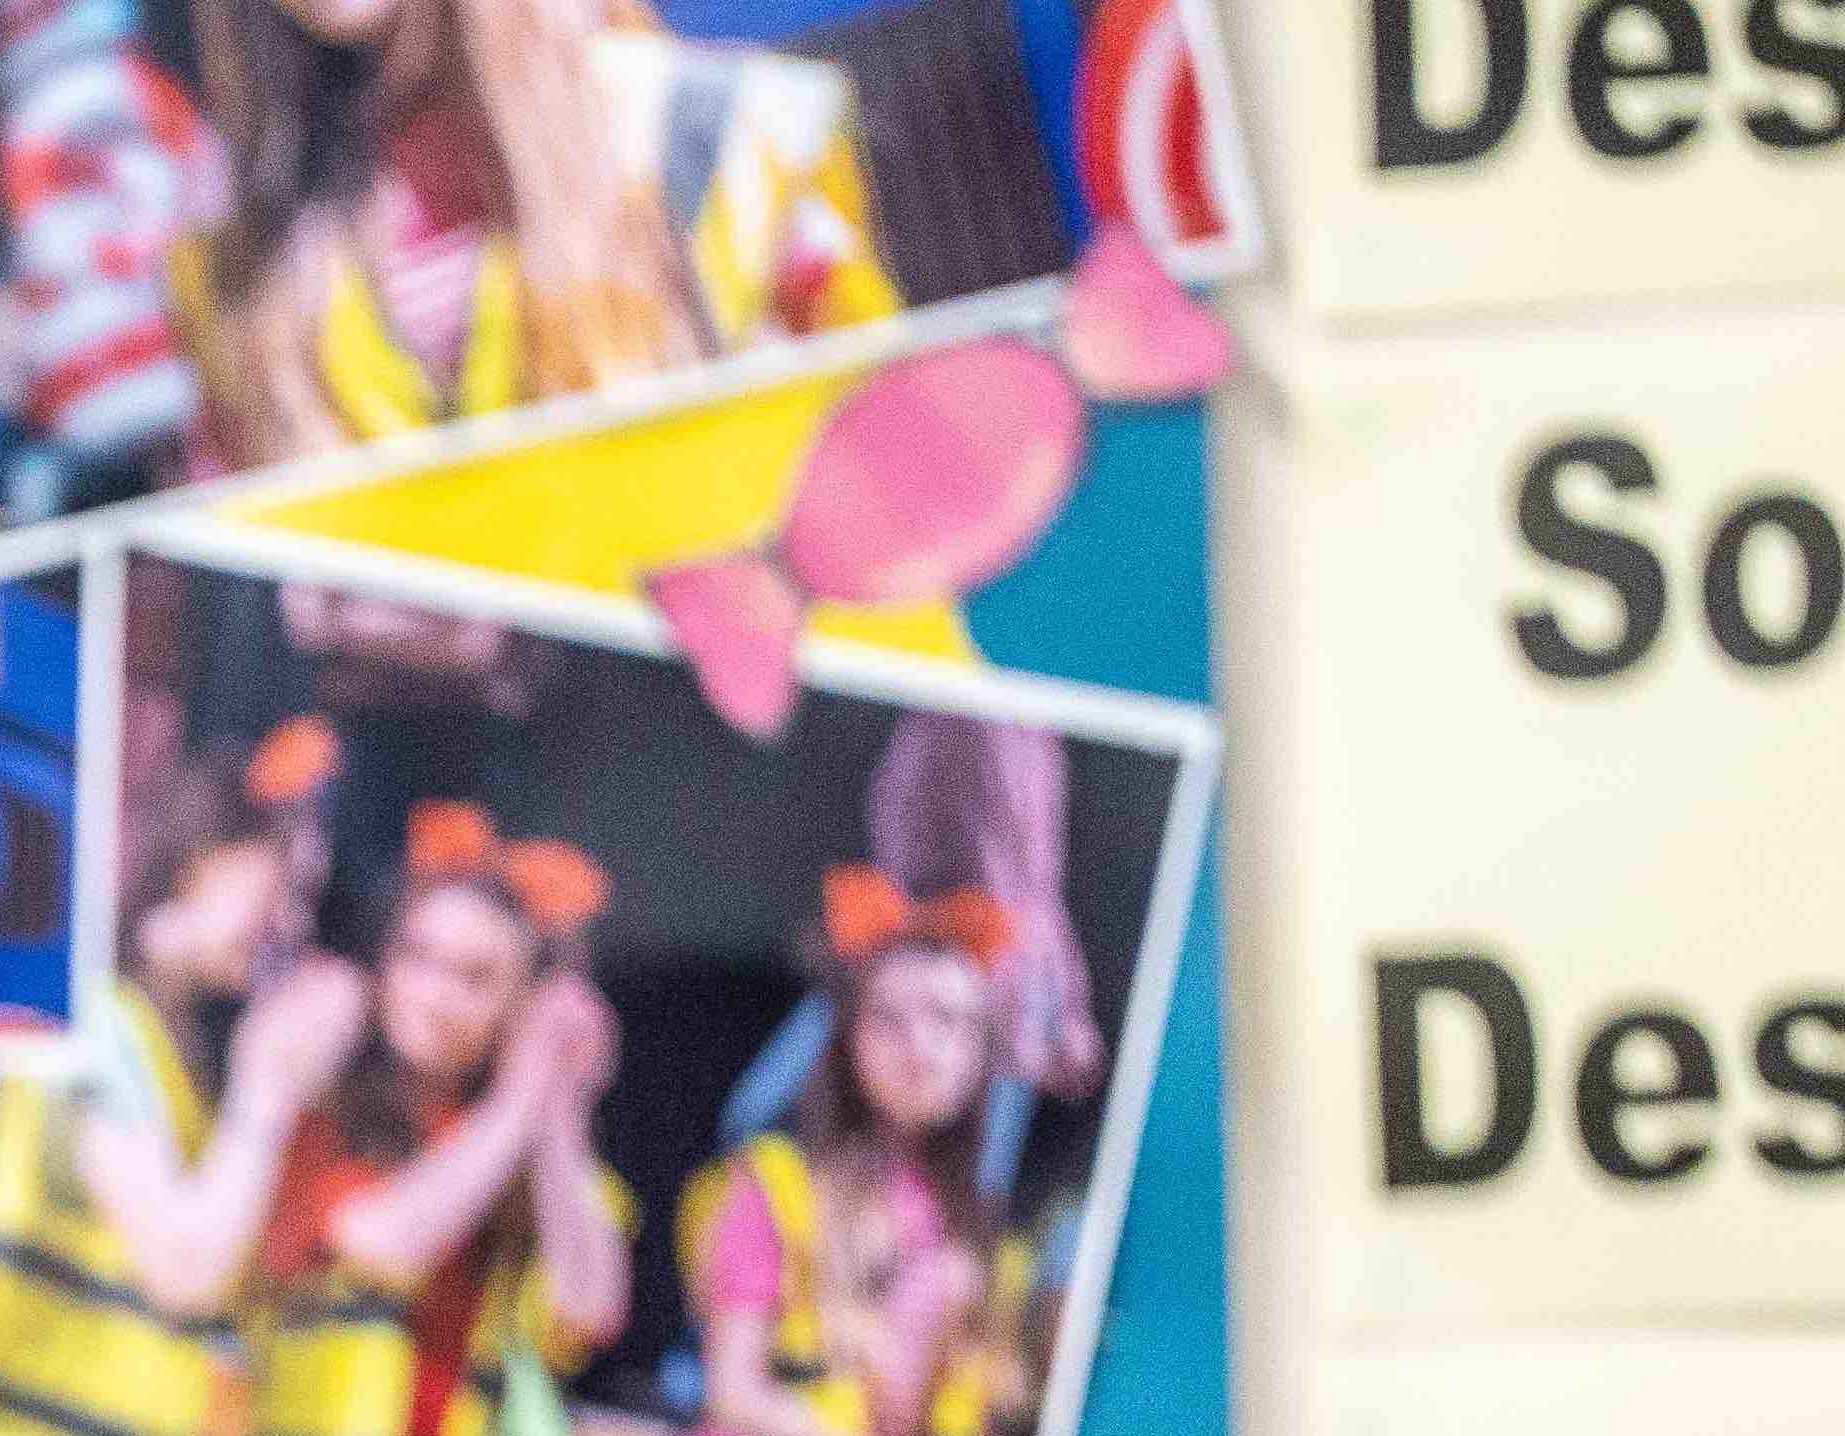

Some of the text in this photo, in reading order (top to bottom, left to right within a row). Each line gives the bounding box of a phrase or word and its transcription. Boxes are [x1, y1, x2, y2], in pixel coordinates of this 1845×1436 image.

[1367, 0, 1845, 172] Des
[1512, 434, 1845, 681] So
[1373, 953, 1845, 1190] Des
